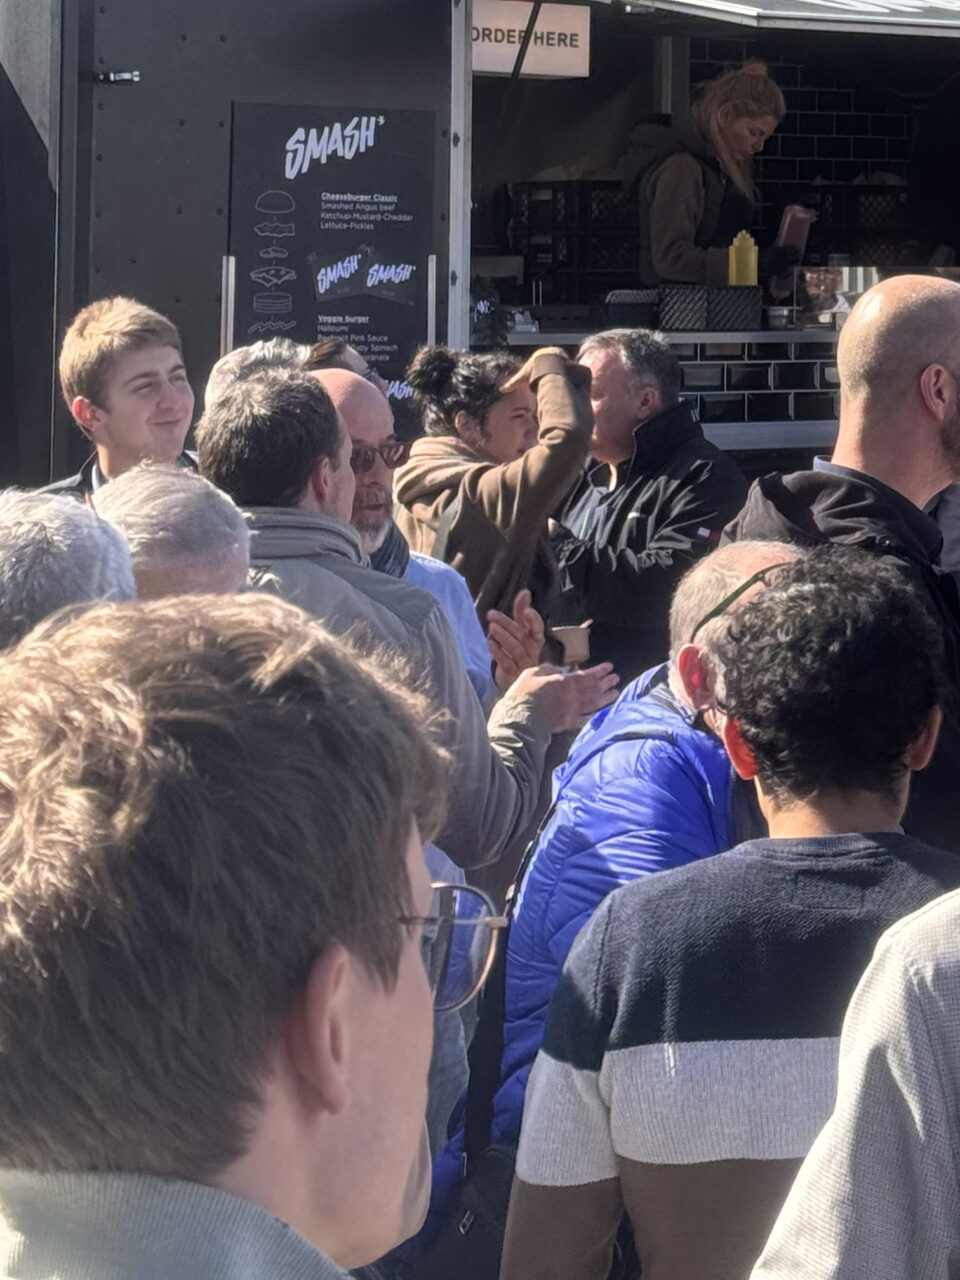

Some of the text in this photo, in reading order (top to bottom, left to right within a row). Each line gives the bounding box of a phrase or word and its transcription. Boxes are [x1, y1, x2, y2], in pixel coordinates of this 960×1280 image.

[534, 31, 579, 49] HERE
[285, 116, 377, 180] SMASH
[321, 192, 398, 203] Cheeseburger Classic
[321, 202, 396, 212] Smashed Angus beef
[317, 254, 359, 294] SMASH
[366, 264, 413, 288] SMASH
[318, 314, 370, 324] Veggie burger
[367, 333, 389, 342] Sauce
[370, 343, 399, 353] Spinach
[386, 380, 414, 400] ASH
